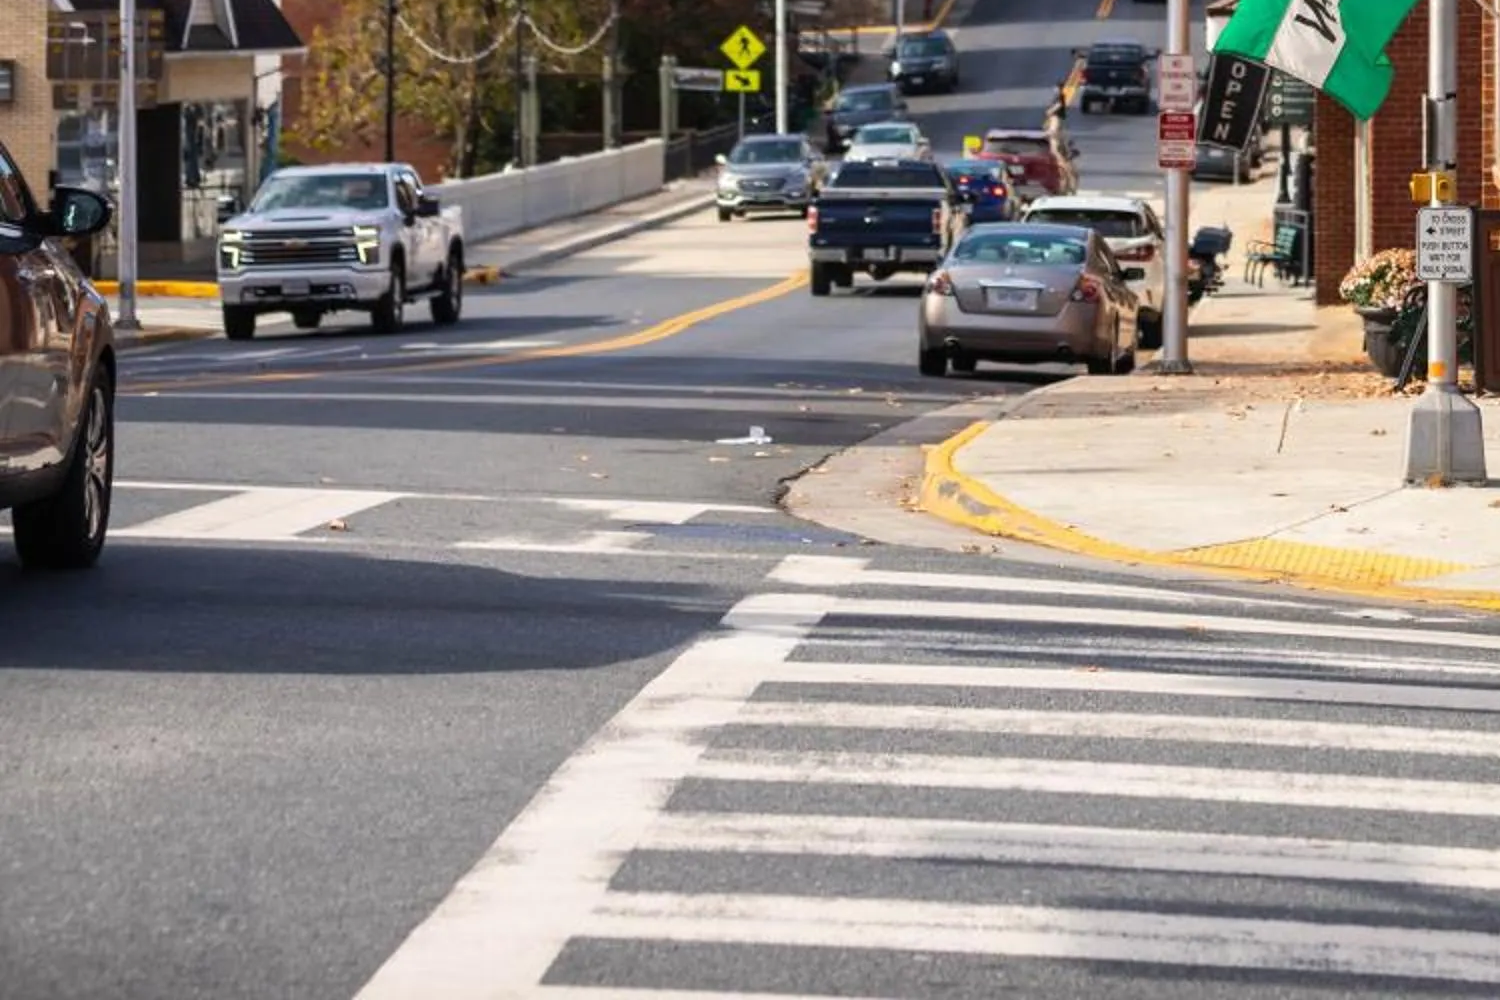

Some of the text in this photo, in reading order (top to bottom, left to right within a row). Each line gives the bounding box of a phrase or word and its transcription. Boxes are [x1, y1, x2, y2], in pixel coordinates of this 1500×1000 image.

[1213, 61, 1247, 141] OPEN
[1442, 215, 1467, 225] CROSS
[1440, 227, 1466, 236] STREET
[1421, 241, 1469, 250] PUSH BUTTON
[1422, 265, 1467, 274] WALK SIGNAL
